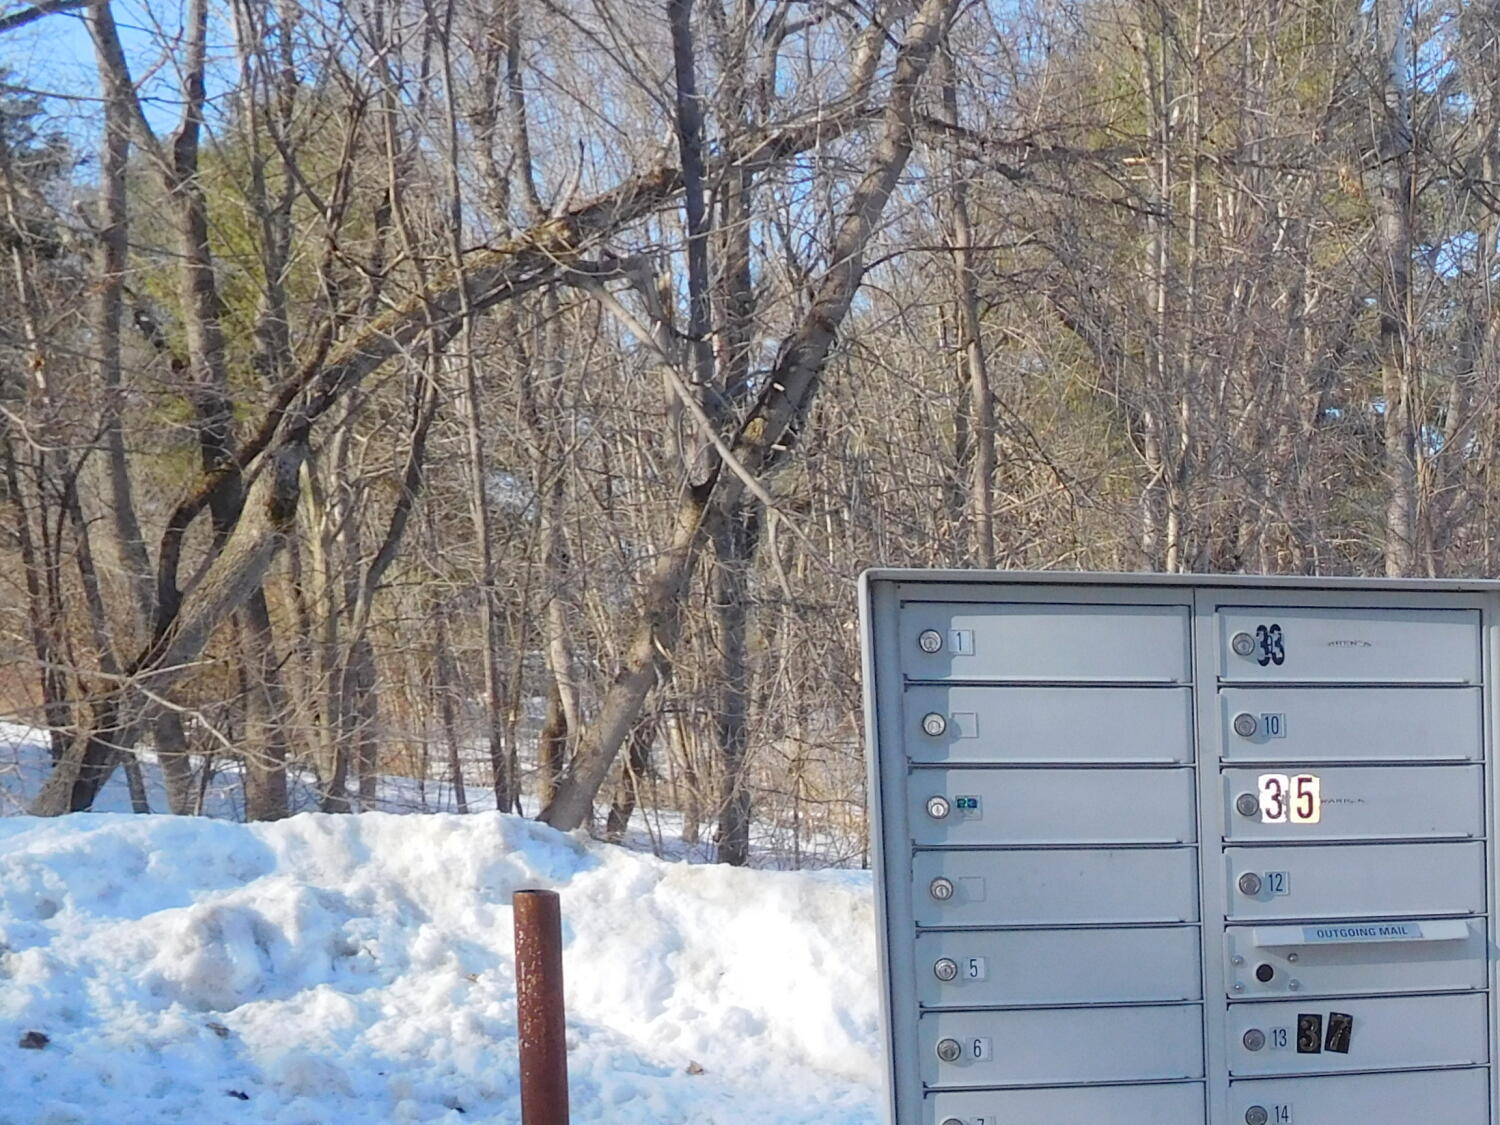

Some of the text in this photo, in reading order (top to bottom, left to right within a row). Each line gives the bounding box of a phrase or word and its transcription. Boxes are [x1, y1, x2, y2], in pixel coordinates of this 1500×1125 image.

[956, 631, 962, 651] 1
[1264, 715, 1280, 735] 10
[1264, 777, 1314, 819] 35
[1268, 873, 1284, 892] 12
[1316, 926, 1409, 938] OUTGOING MAIL
[969, 958, 979, 978] 5
[1272, 1028, 1288, 1047] 13
[973, 1039, 982, 1058] 6
[1274, 1105, 1290, 1123] 14
